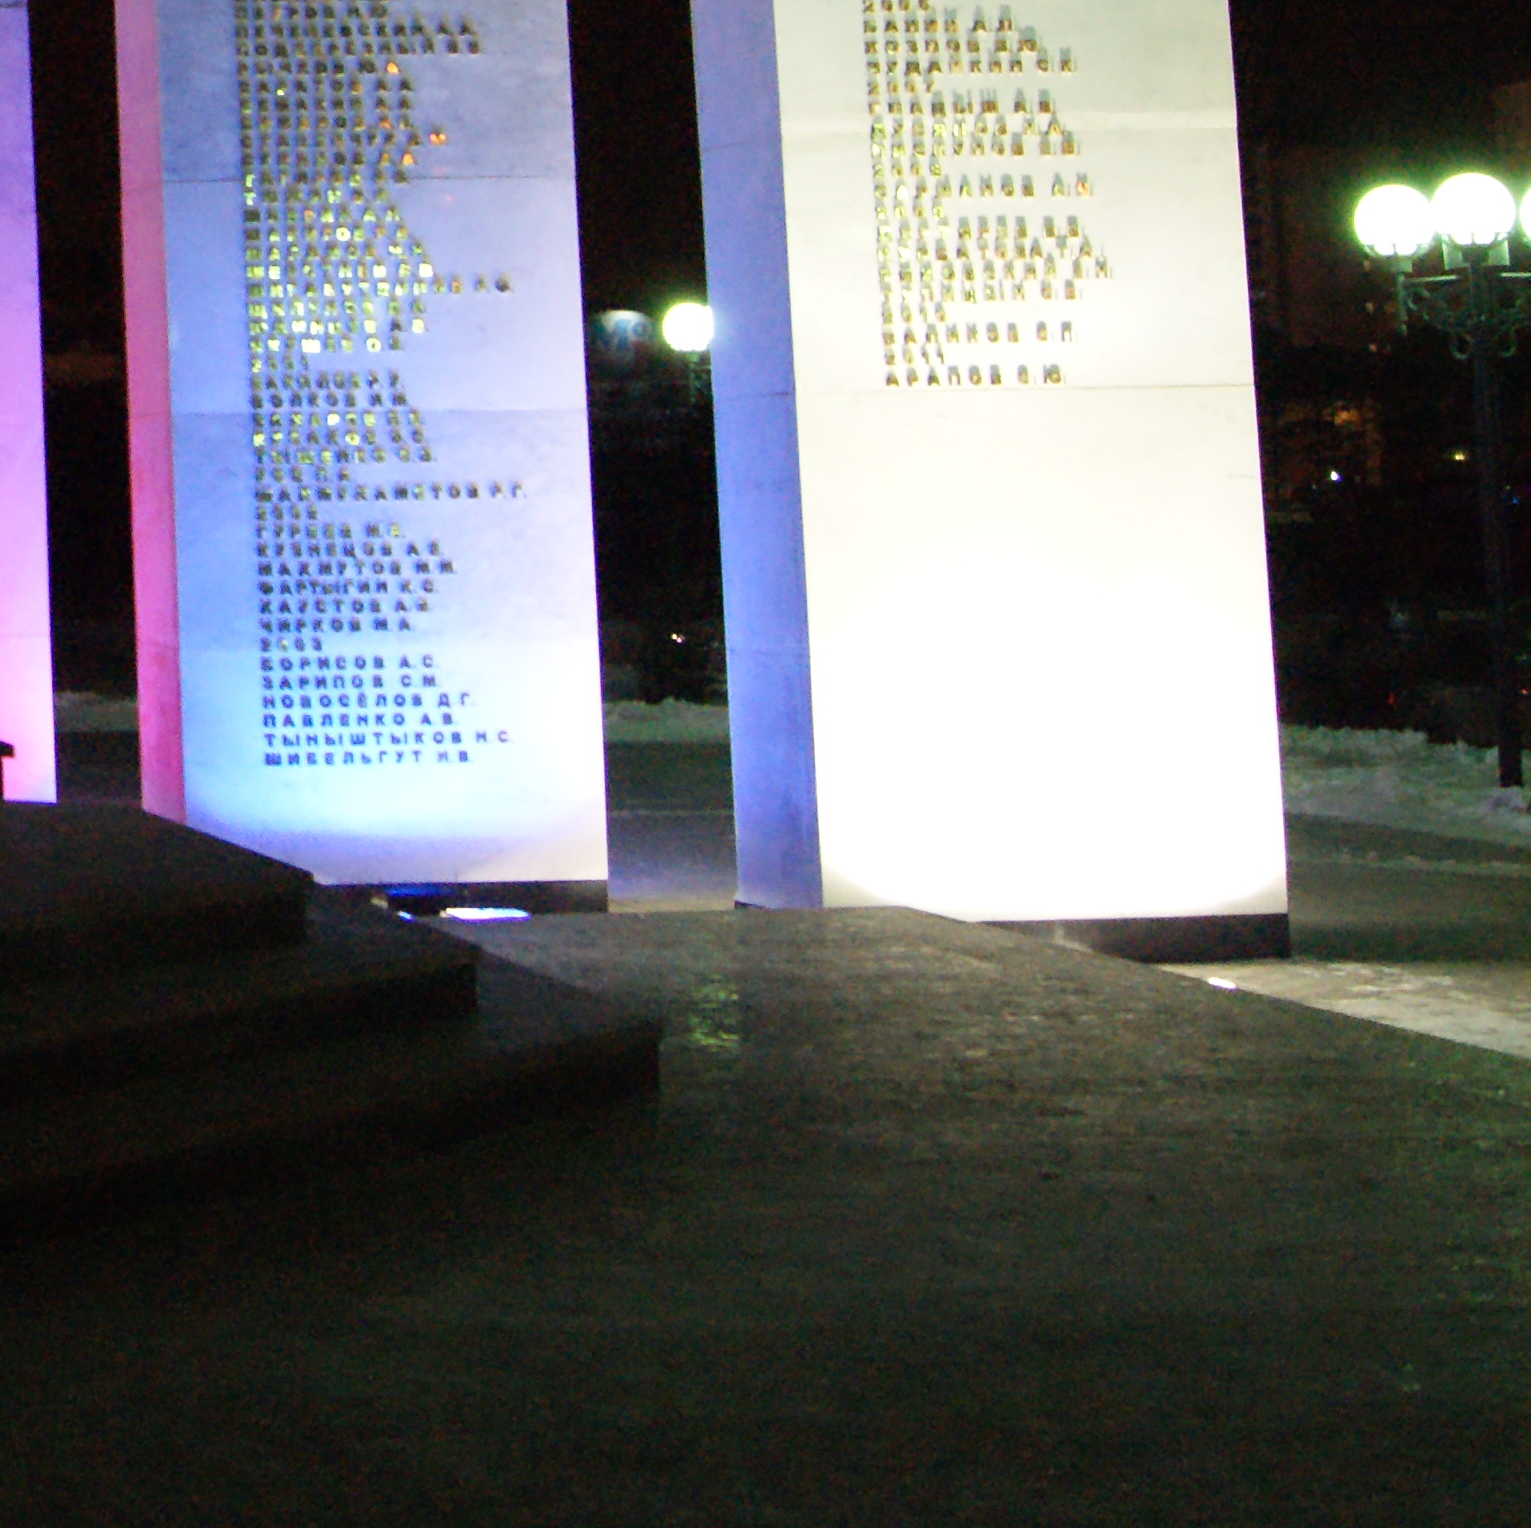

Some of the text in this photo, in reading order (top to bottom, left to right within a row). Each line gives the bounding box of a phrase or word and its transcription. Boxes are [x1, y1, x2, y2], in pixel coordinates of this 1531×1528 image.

[885, 364, 1003, 387] АРАПОВ
[260, 656, 385, 671] БОРИСОВ
[261, 674, 384, 690] ЗАРИПОВ
[263, 713, 405, 727] ПАВЛЕНКО
